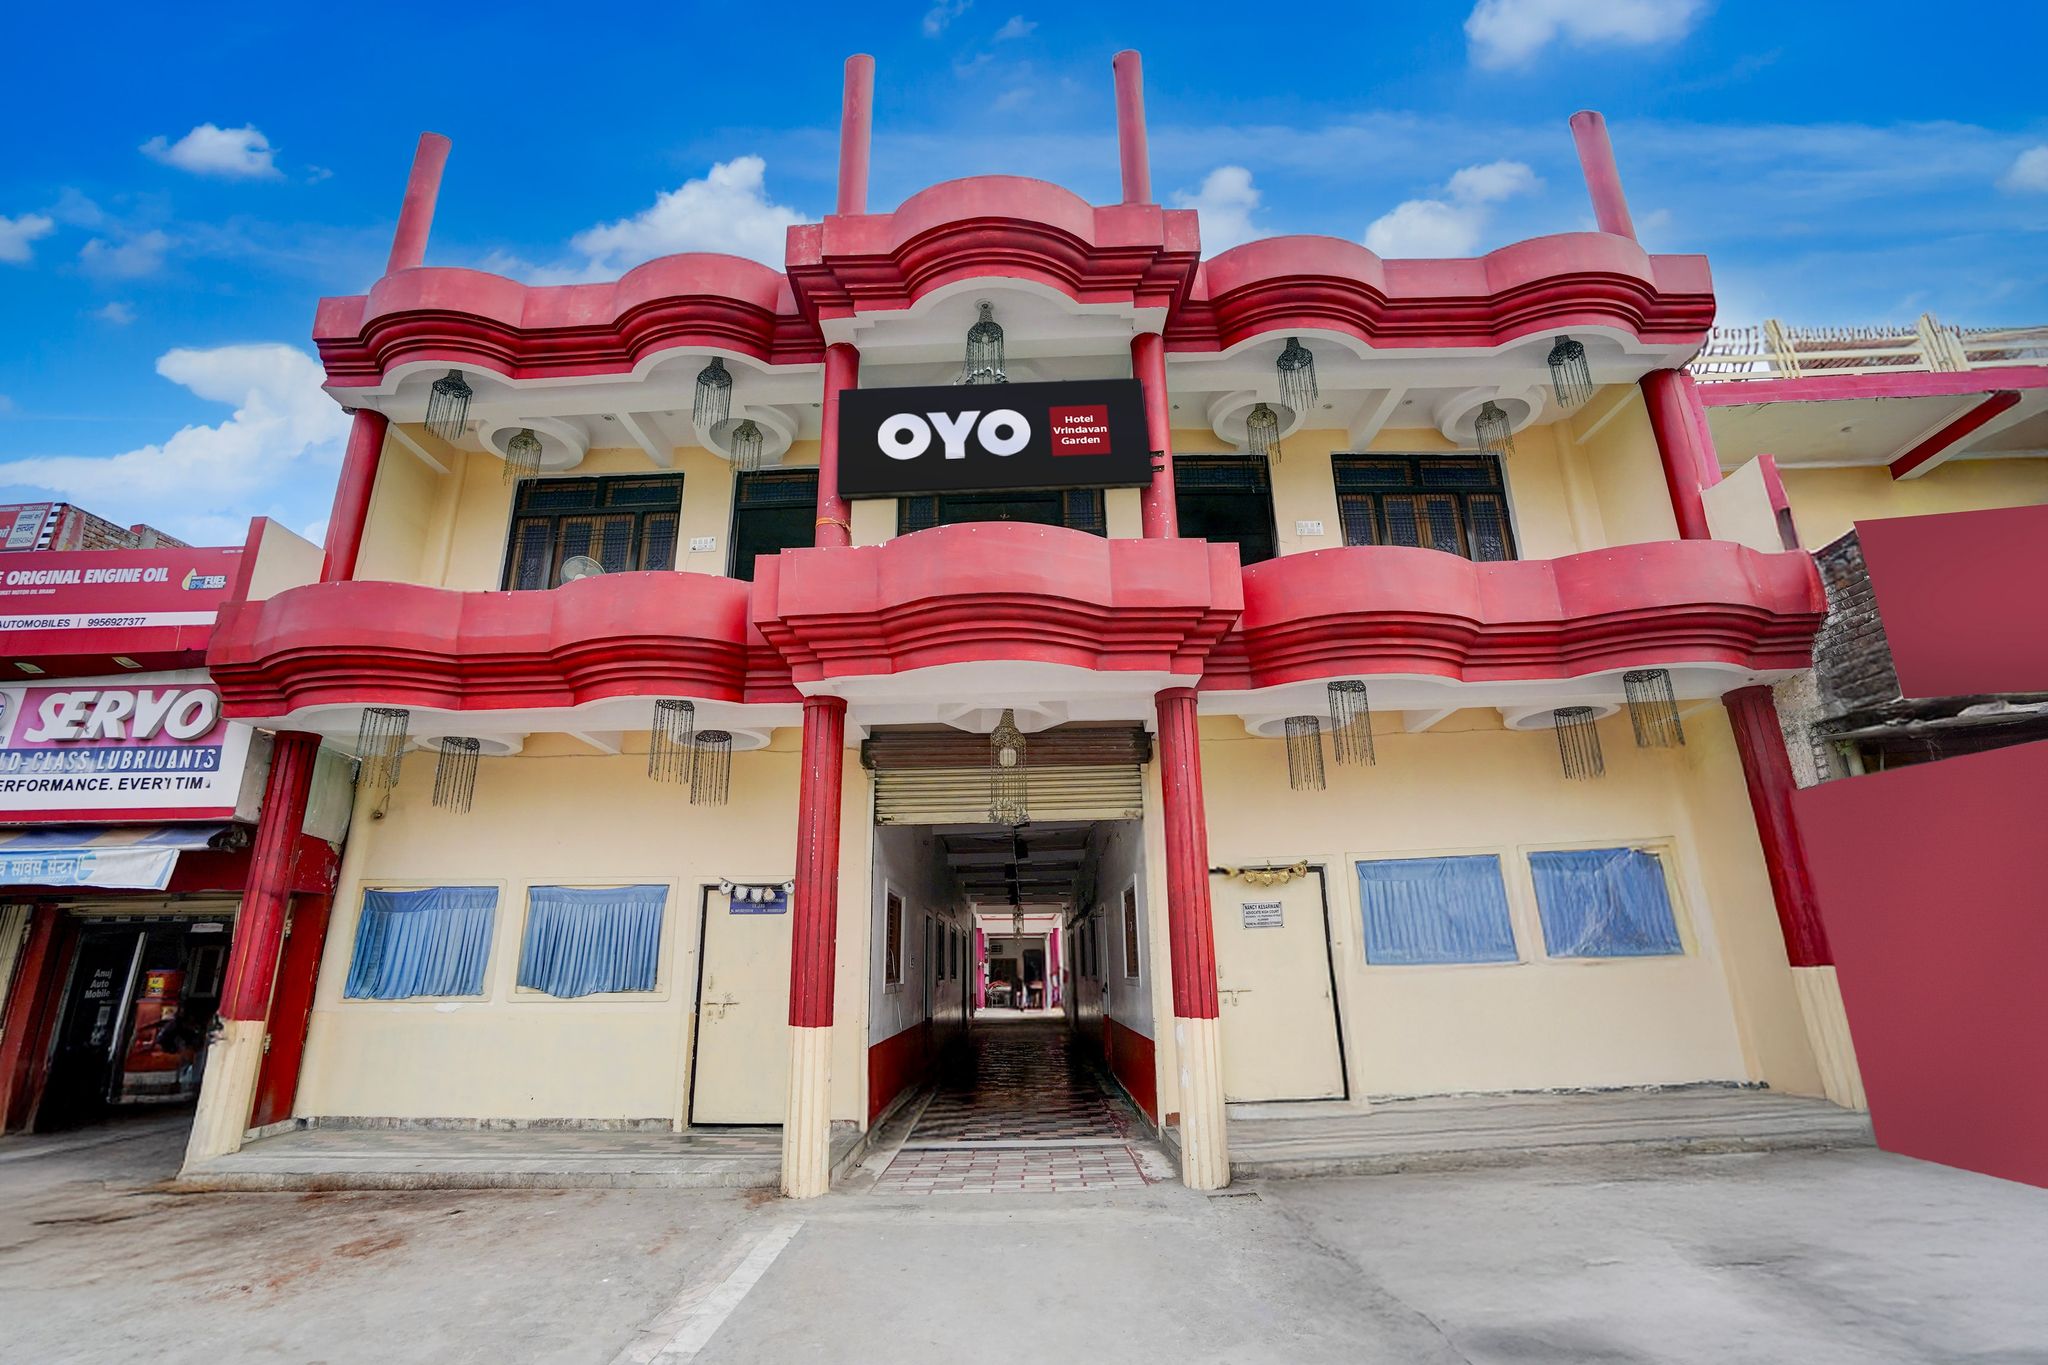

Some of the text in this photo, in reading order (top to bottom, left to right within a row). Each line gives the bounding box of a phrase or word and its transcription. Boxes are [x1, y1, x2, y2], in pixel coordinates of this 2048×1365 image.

[1064, 414, 1094, 424] Hotel
[877, 408, 1032, 460] OYO
[1053, 425, 1108, 435] Vrindavan
[1061, 435, 1101, 445] Garden
[6, 569, 81, 586] ORIGINAL
[83, 568, 143, 584] ENGINE
[142, 567, 169, 582] OIL
[87, 617, 147, 627] 9956927377
[23, 688, 220, 743] SERVO
[94, 968, 113, 979] Anuj
[90, 979, 110, 989] Auto
[84, 989, 111, 999] Mobile
